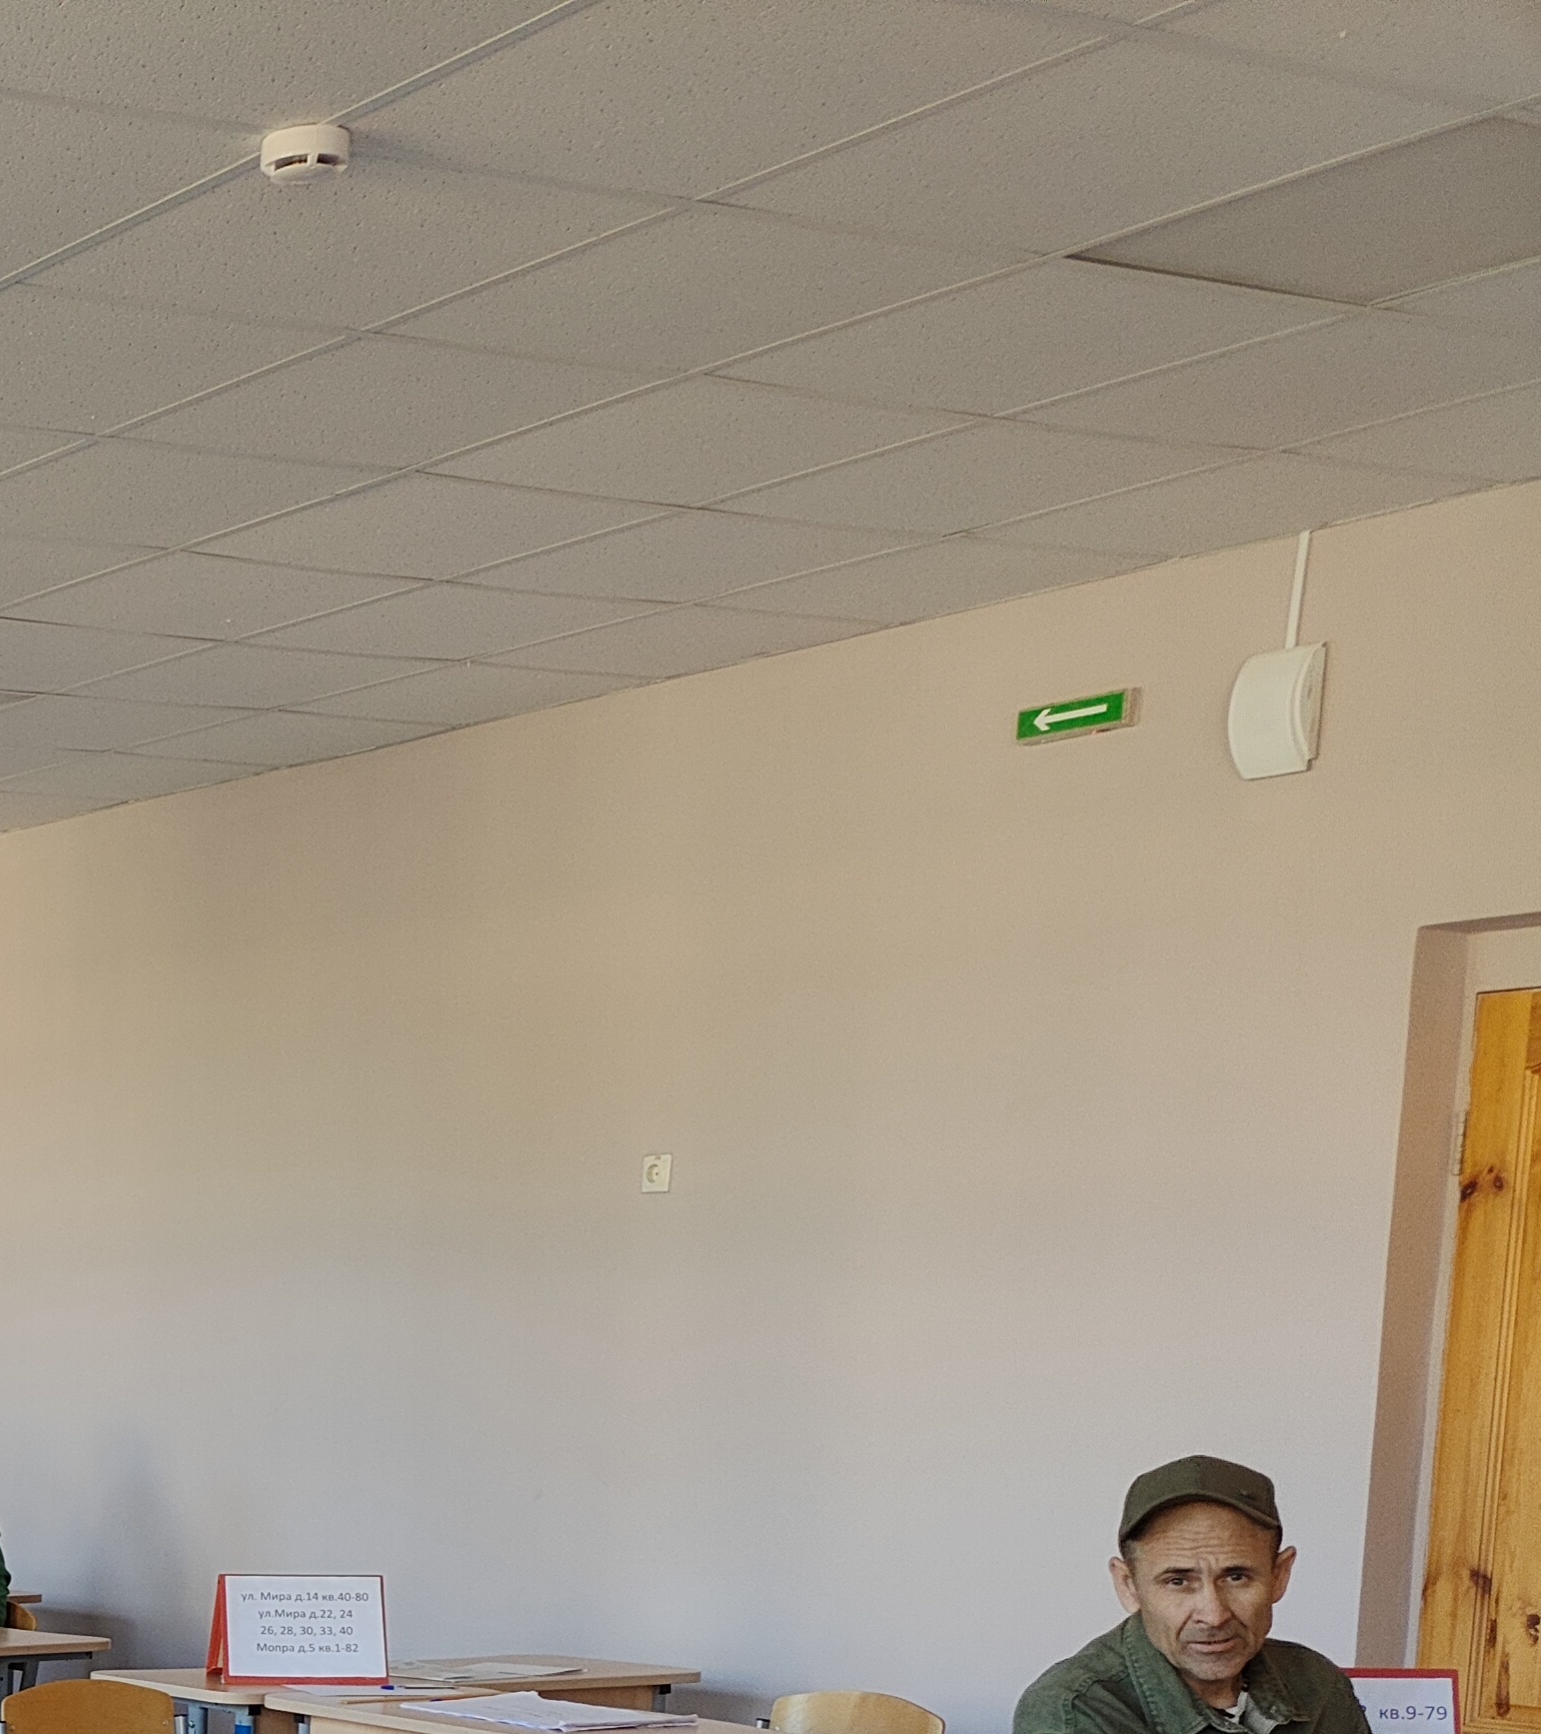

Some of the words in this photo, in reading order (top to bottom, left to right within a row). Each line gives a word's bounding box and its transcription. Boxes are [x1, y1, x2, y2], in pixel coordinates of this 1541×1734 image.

[240, 1593, 257, 1602] ул.
[260, 1592, 292, 1602] Мира
[294, 1592, 319, 1602] д.14
[322, 1592, 369, 1602] кв.40-80
[308, 1609, 337, 1619] д.22,
[339, 1609, 353, 1618] 24
[260, 1626, 277, 1636] 26,
[280, 1626, 297, 1636] 28,
[300, 1626, 317, 1636] 30,
[319, 1626, 337, 1636] 33,
[339, 1626, 354, 1635] 40
[256, 1643, 295, 1653] Мопра
[297, 1643, 316, 1653] д.5
[318, 1643, 359, 1653] кв.1-82
[1379, 1705, 1448, 1720] кв.9-79
